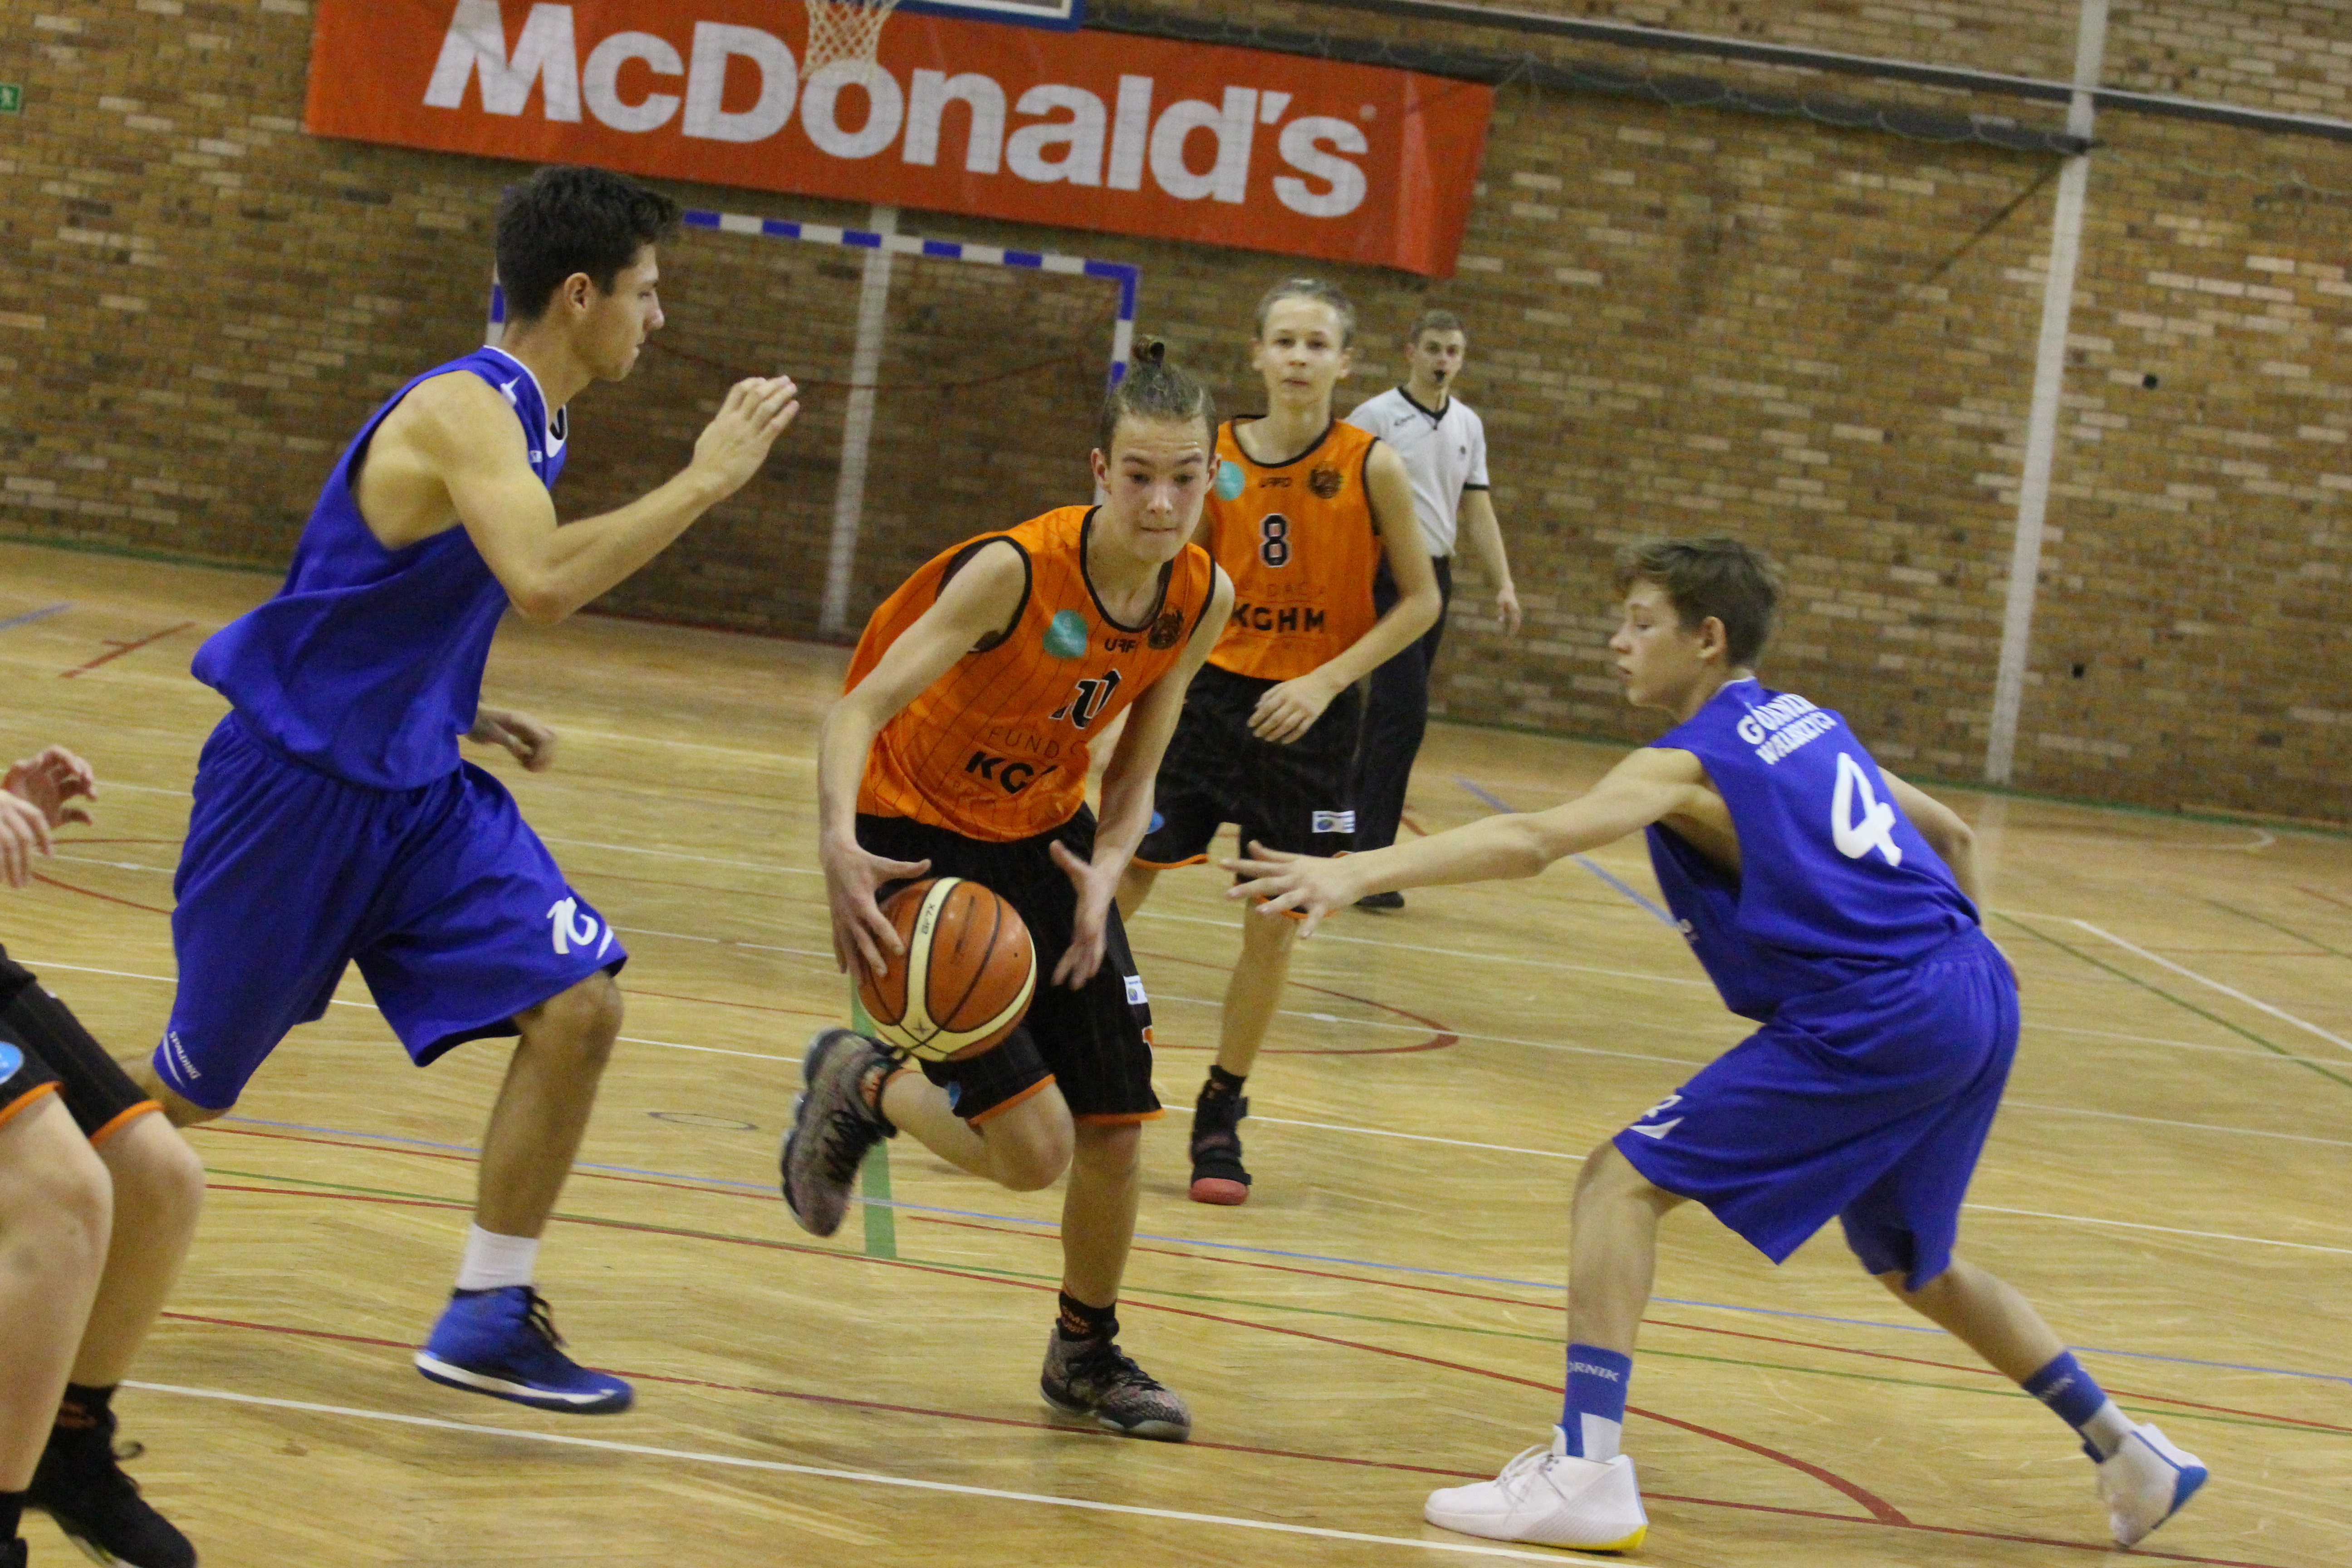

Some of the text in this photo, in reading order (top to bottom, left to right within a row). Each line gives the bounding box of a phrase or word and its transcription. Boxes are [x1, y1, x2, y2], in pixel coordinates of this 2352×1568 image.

[422, 0, 1369, 217] McDonald's
[1259, 513, 1292, 568] 8
[1230, 603, 1328, 633] KGHM
[1831, 751, 1902, 867] 4
